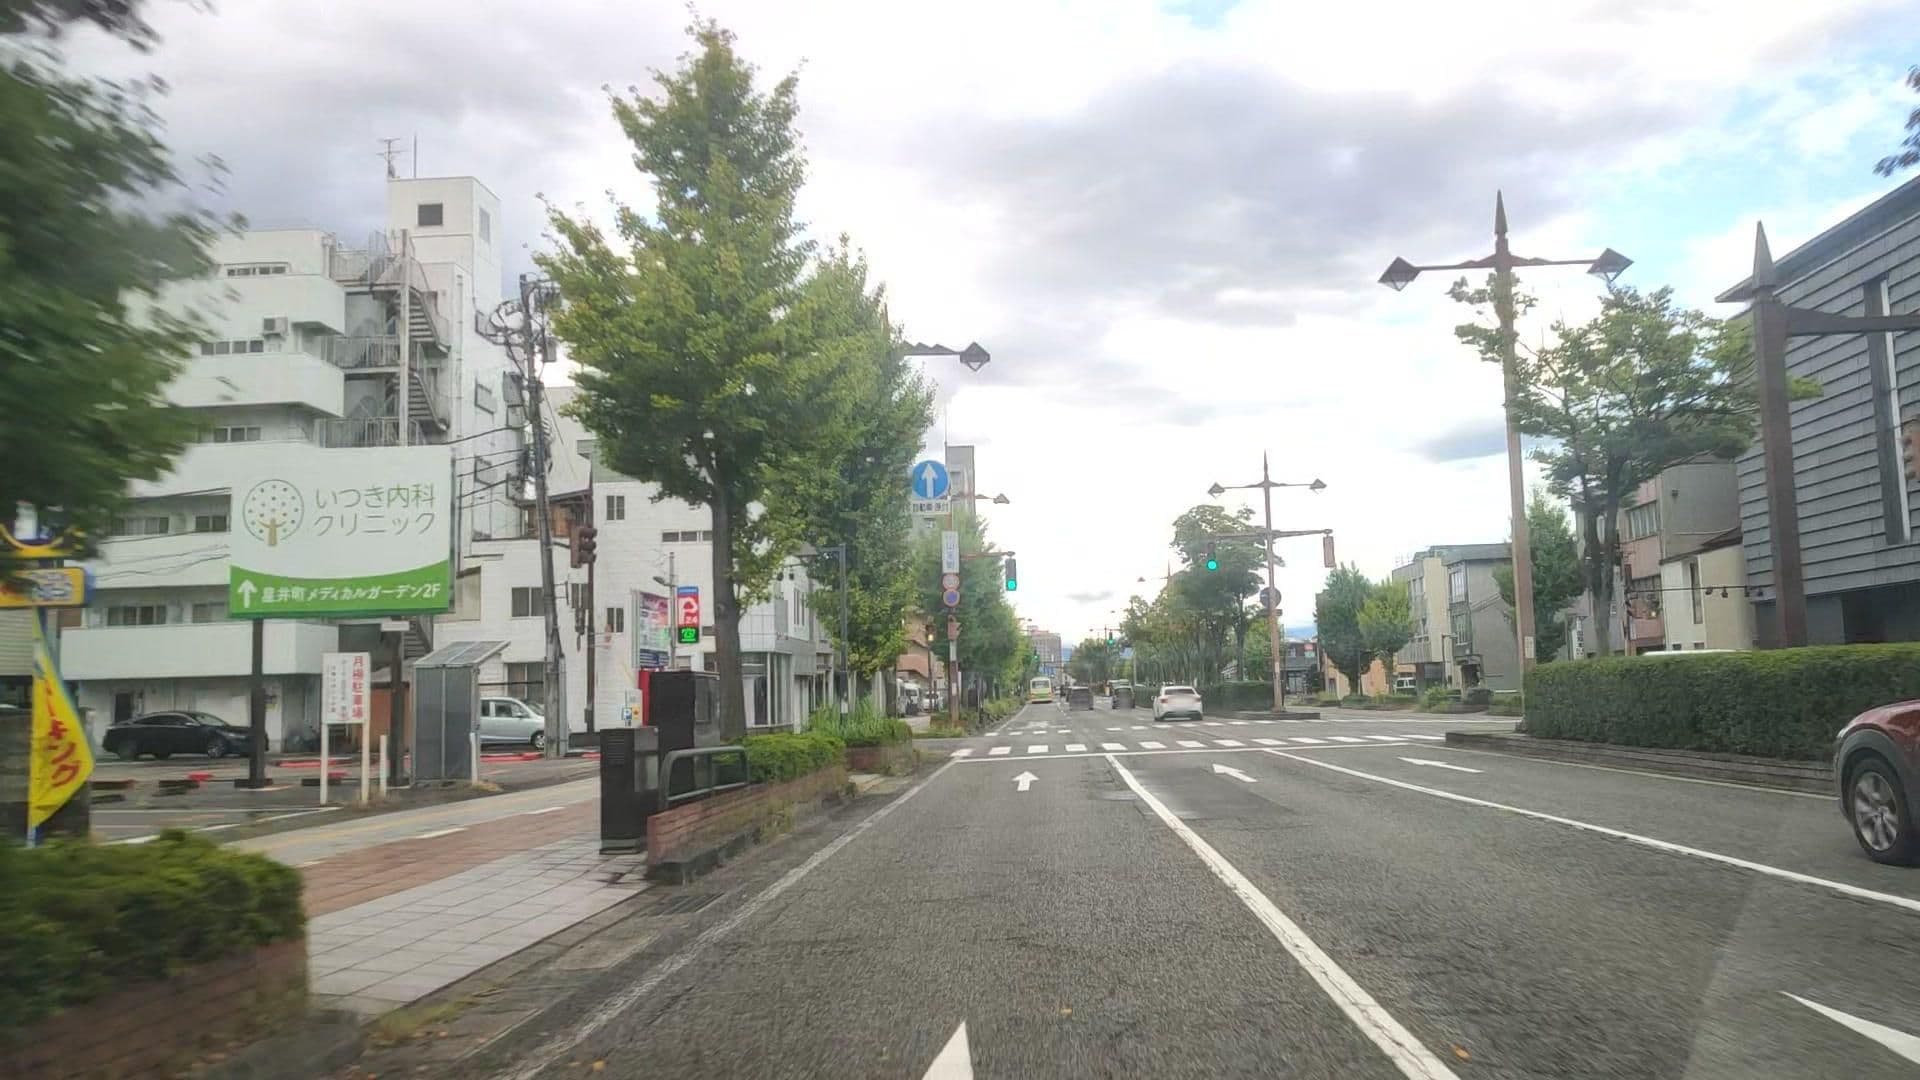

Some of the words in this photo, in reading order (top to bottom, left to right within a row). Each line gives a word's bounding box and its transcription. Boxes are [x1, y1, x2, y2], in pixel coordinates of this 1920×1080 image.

[316, 483, 435, 510] いつき内科
[314, 512, 435, 537] クリニック
[45, 679, 82, 788] ーキング
